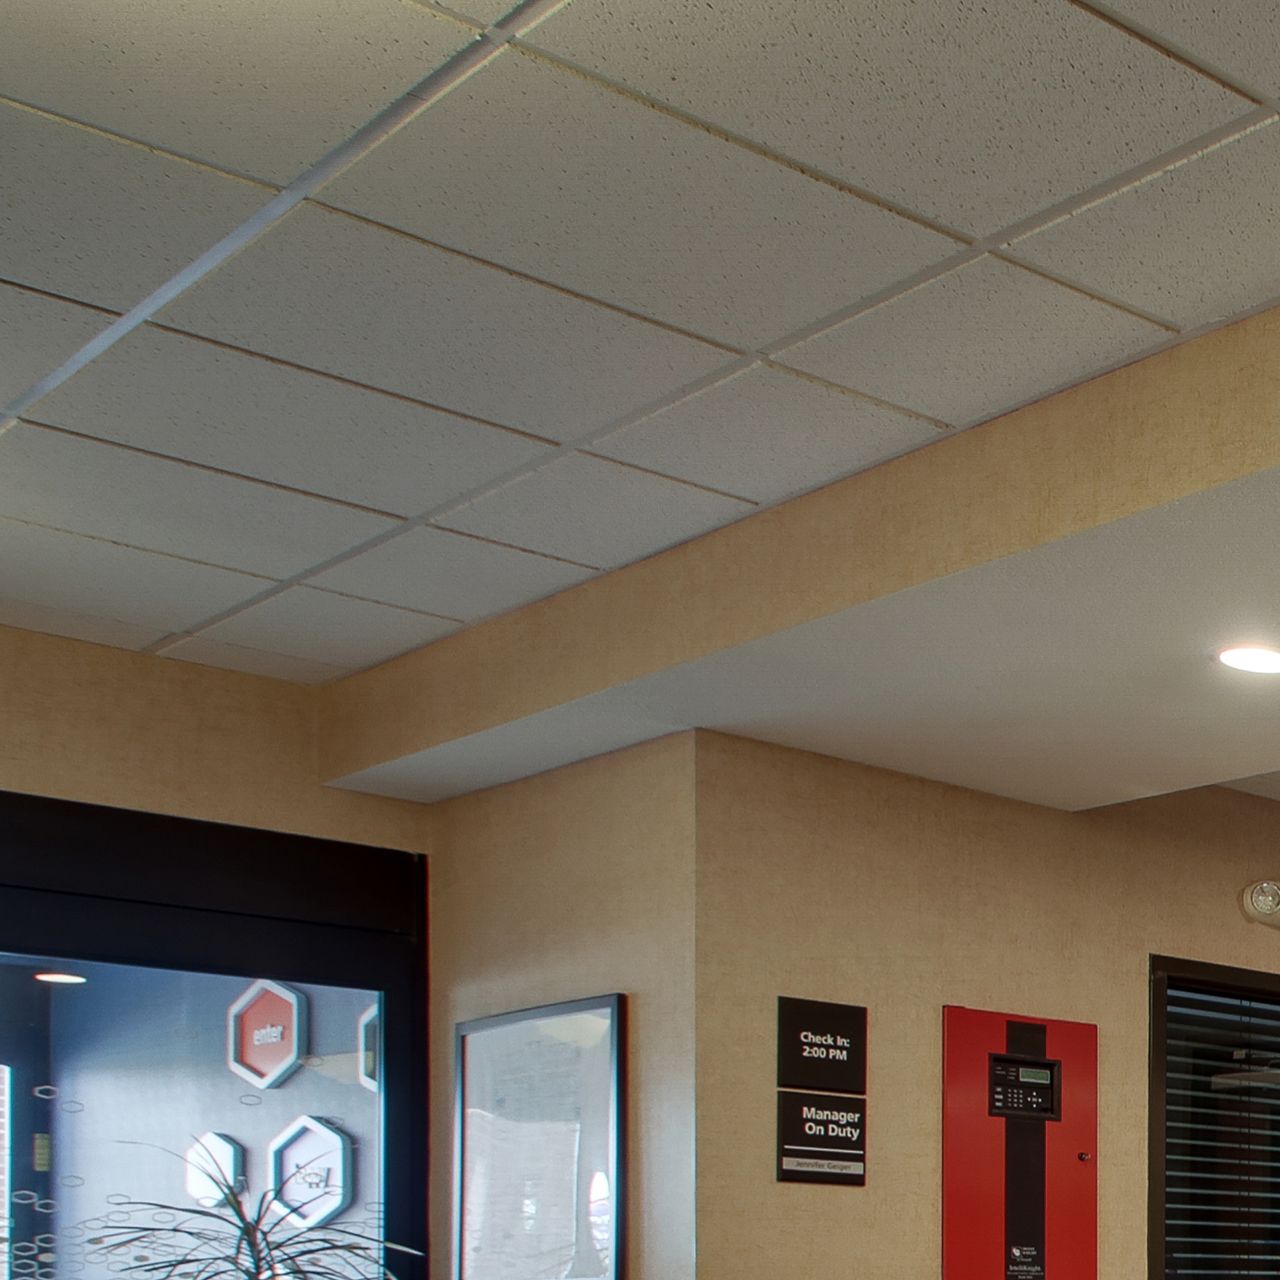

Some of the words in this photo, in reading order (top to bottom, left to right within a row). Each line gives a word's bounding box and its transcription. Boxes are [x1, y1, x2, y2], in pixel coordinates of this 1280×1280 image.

[800, 1031, 834, 1045] Check
[836, 1035, 850, 1047] In:
[802, 1045, 827, 1058] 2:00
[828, 1048, 847, 1060] PM
[802, 1106, 861, 1124] Manager
[804, 1122, 825, 1135] On
[828, 1123, 860, 1141] Duty
